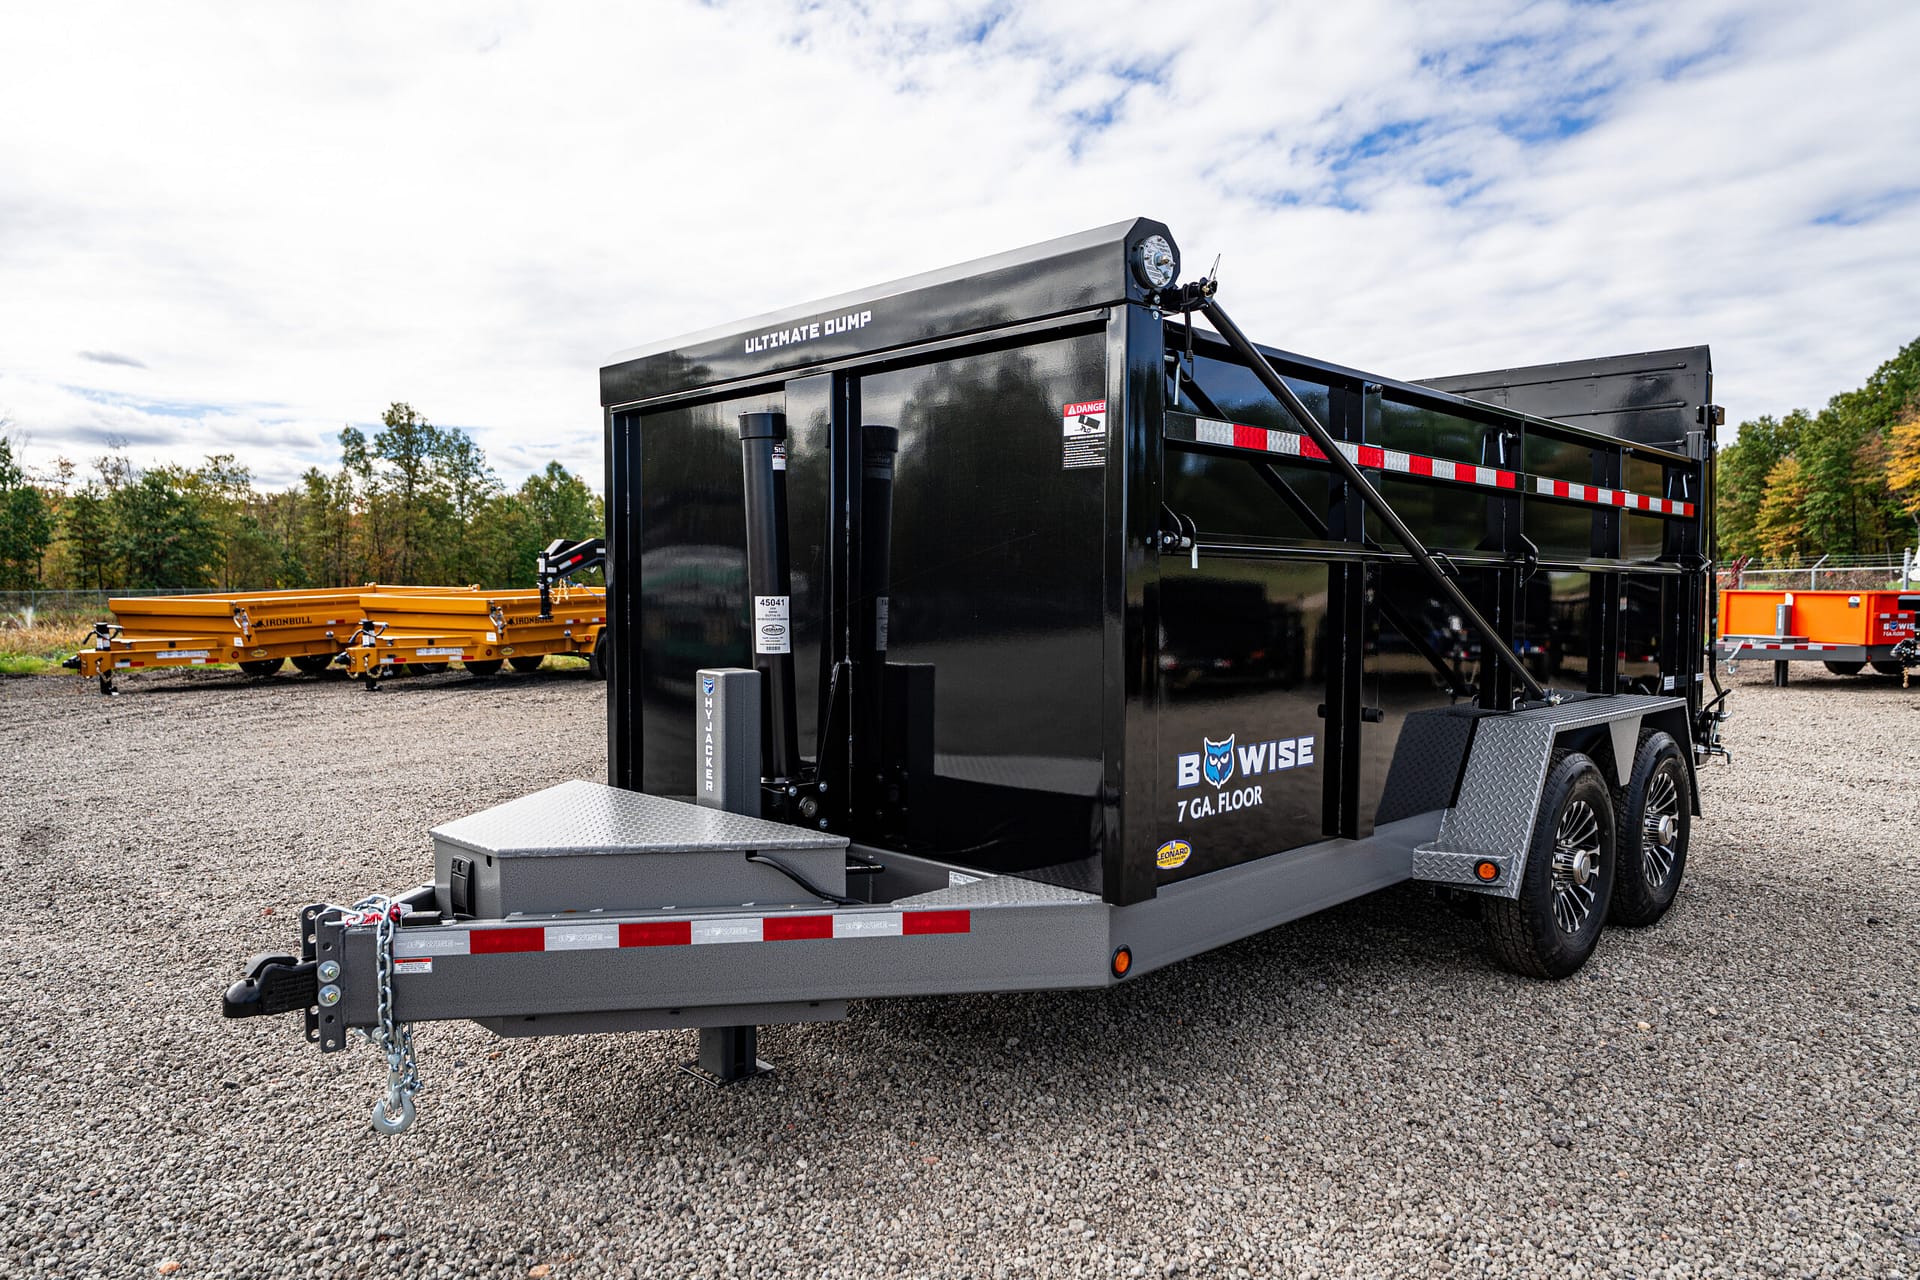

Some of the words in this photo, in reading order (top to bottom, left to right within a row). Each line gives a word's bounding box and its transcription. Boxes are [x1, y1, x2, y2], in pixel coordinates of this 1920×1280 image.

[745, 323, 820, 353] ULTIMATE
[824, 310, 872, 335] DUMP
[760, 598, 785, 606] 45041
[265, 616, 312, 627] IRONBULL
[704, 697, 713, 792] HYJACKER
[1177, 800, 1188, 823] 7
[1190, 797, 1216, 820] GA.
[1218, 785, 1263, 814] FLOOR
